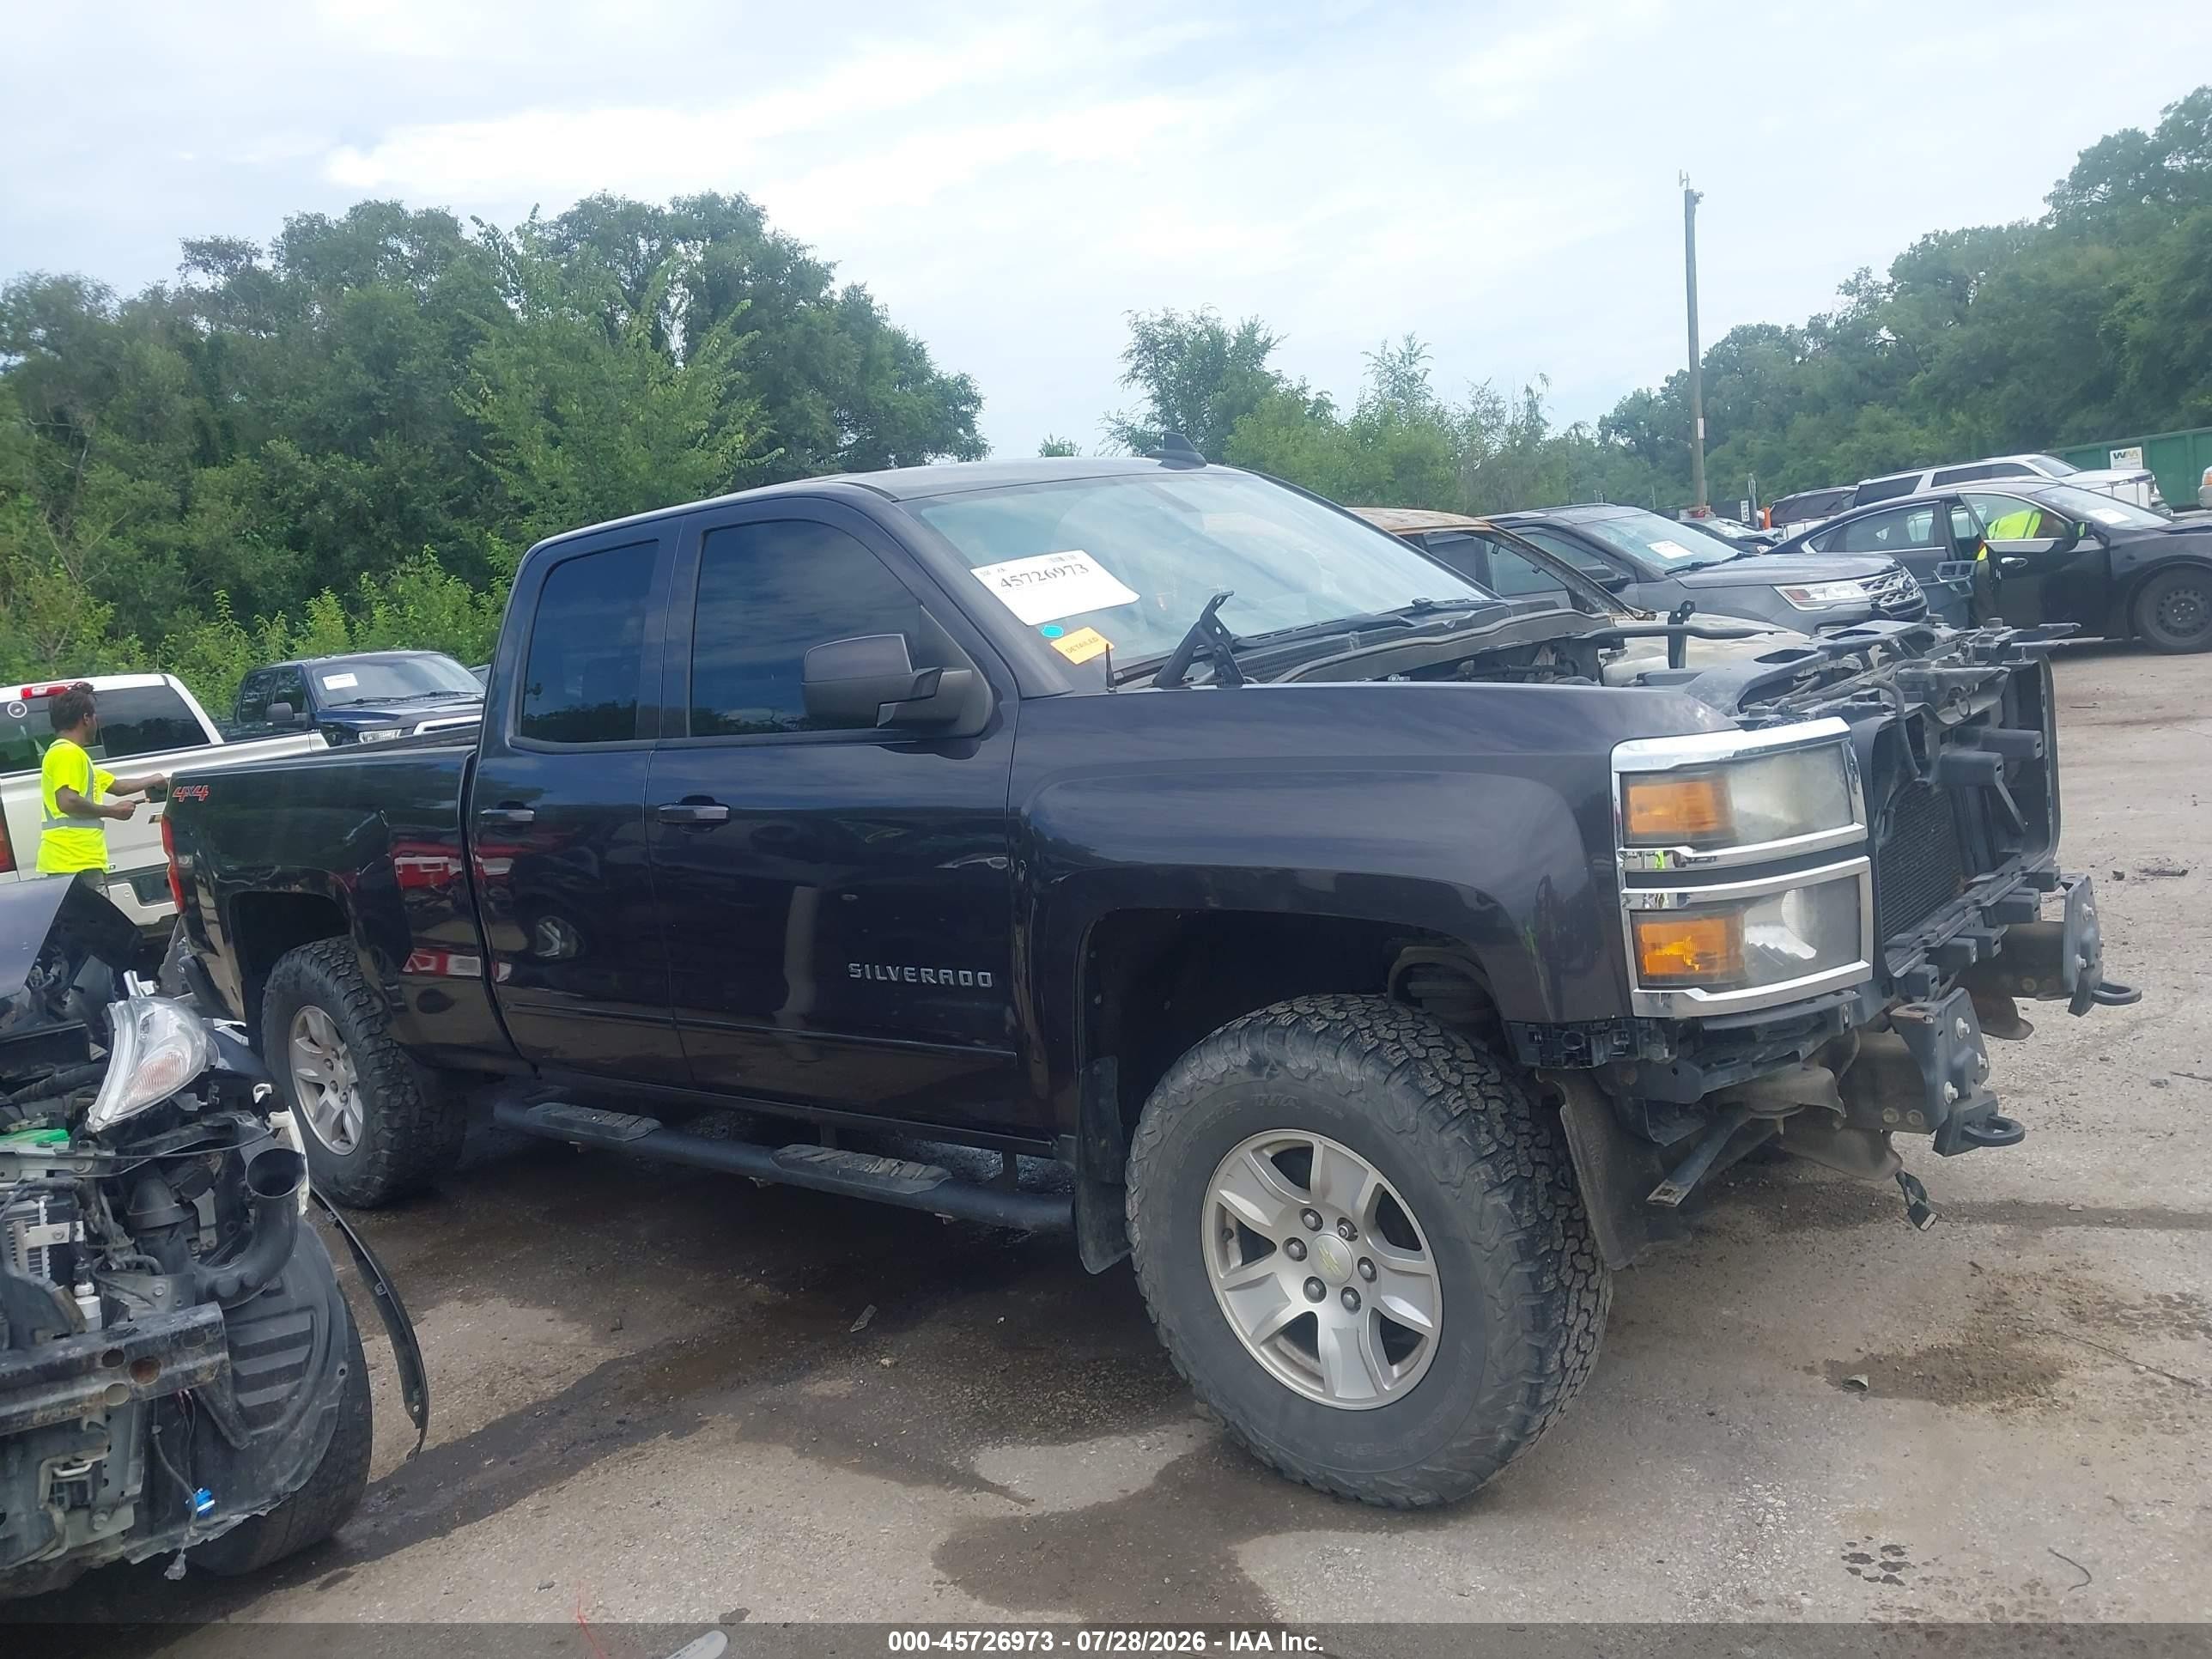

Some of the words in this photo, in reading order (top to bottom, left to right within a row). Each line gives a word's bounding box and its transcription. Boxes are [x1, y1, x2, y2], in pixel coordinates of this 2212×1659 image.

[1000, 563, 1089, 587] 45726973
[1065, 637, 1099, 653] DETAILED
[848, 963, 993, 988] SILVERADO
